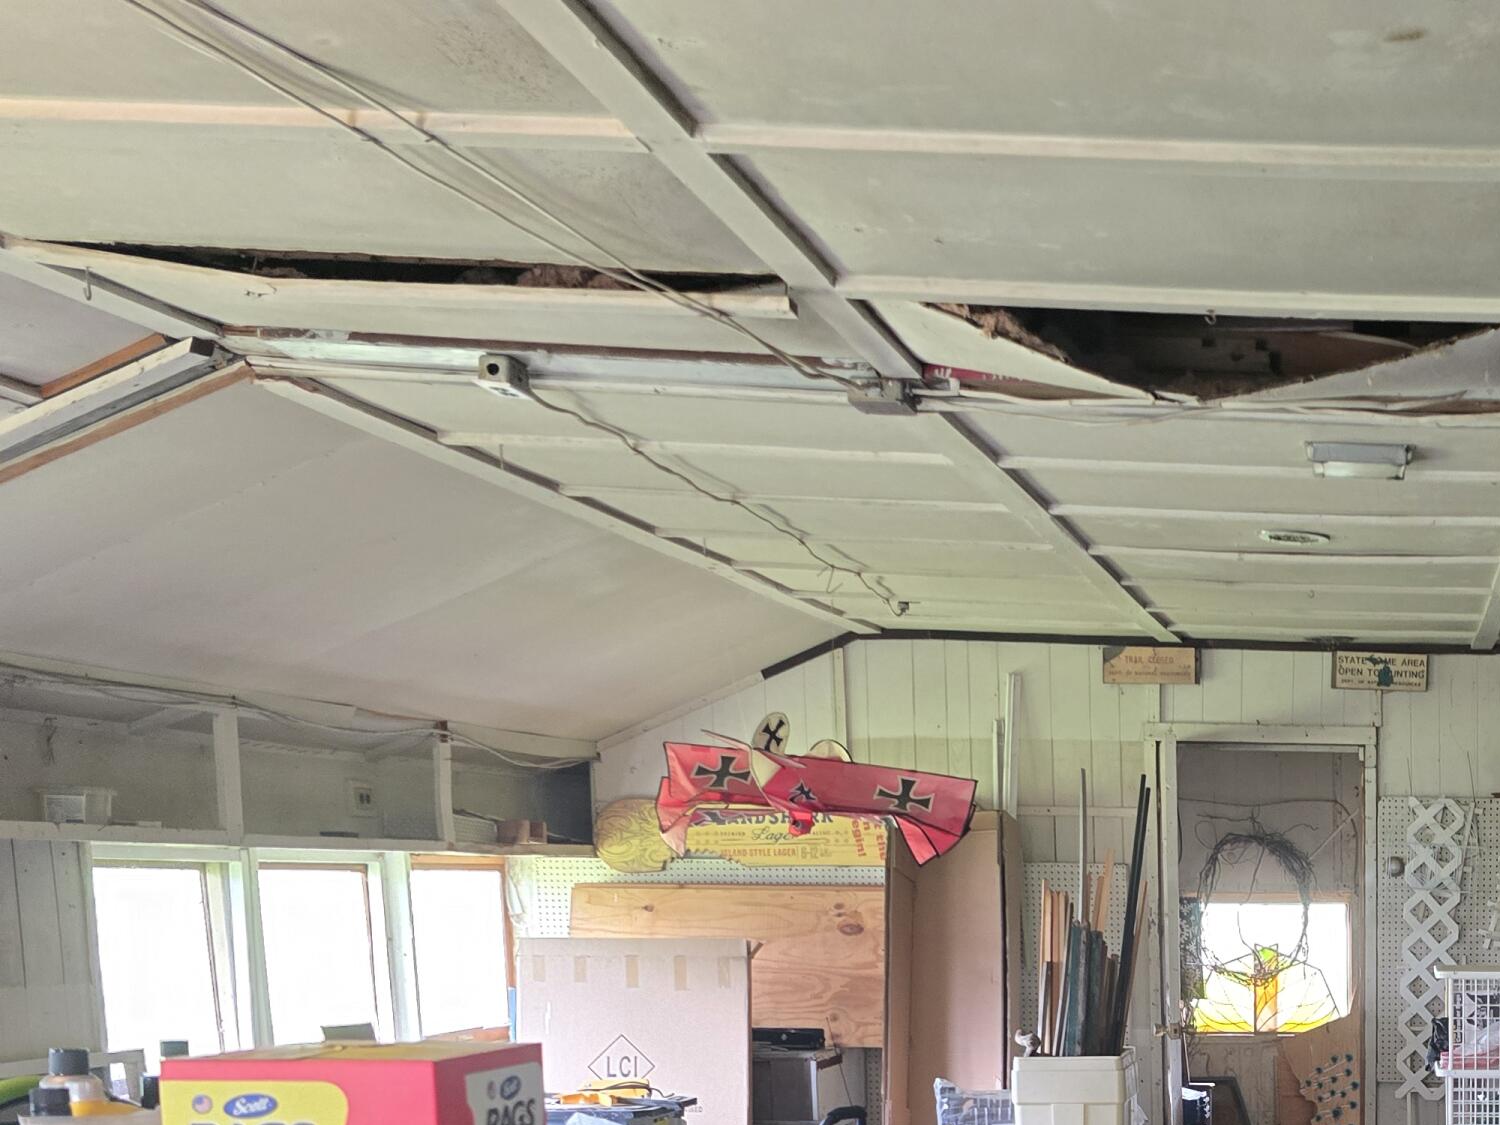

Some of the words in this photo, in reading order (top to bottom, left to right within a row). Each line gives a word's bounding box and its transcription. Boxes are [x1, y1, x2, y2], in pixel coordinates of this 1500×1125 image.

[1338, 655, 1367, 665] STATE
[1401, 658, 1425, 667] AREA
[1338, 667, 1363, 676] OPEN
[1367, 668, 1379, 677] TO
[1391, 669, 1425, 679] UNTING
[751, 826, 793, 844] Lage
[851, 819, 867, 857] egin!
[773, 847, 797, 857] LAGER
[607, 1055, 637, 1078] LCI
[232, 1096, 269, 1116] Scott
